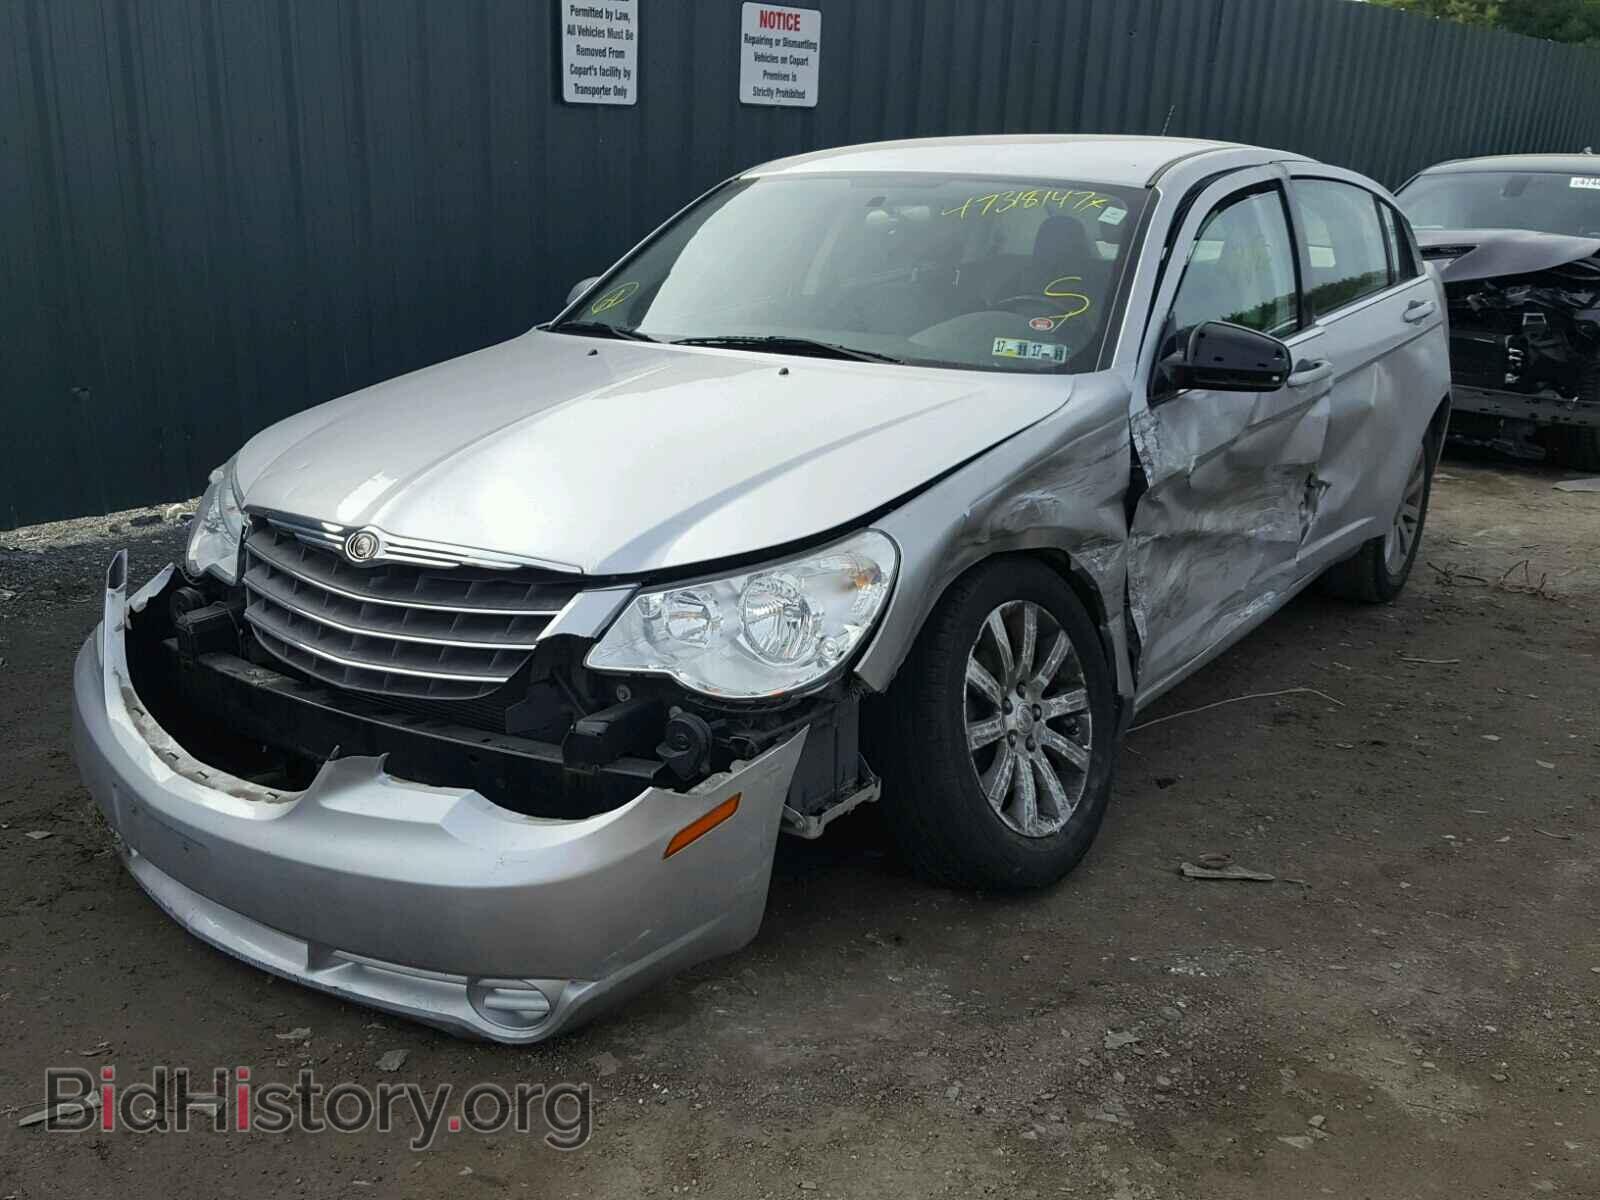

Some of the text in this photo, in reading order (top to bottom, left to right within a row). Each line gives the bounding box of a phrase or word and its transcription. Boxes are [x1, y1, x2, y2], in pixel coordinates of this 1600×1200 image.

[570, 5, 631, 24] Permitted by Law,
[759, 10, 801, 32] NOTICE
[567, 24, 634, 41] All Vehicles Must Be
[744, 33, 818, 53] Repairing or Dismantling
[576, 44, 625, 59] Removed From
[754, 51, 809, 67] Vehicles on Copart
[570, 64, 632, 81] Copart's facility by
[763, 70, 797, 82] Premises is
[574, 83, 628, 99] Transporter Only
[752, 86, 806, 99] Strictly Prohibited
[995, 340, 1006, 353] 17
[1032, 344, 1042, 357] 17
